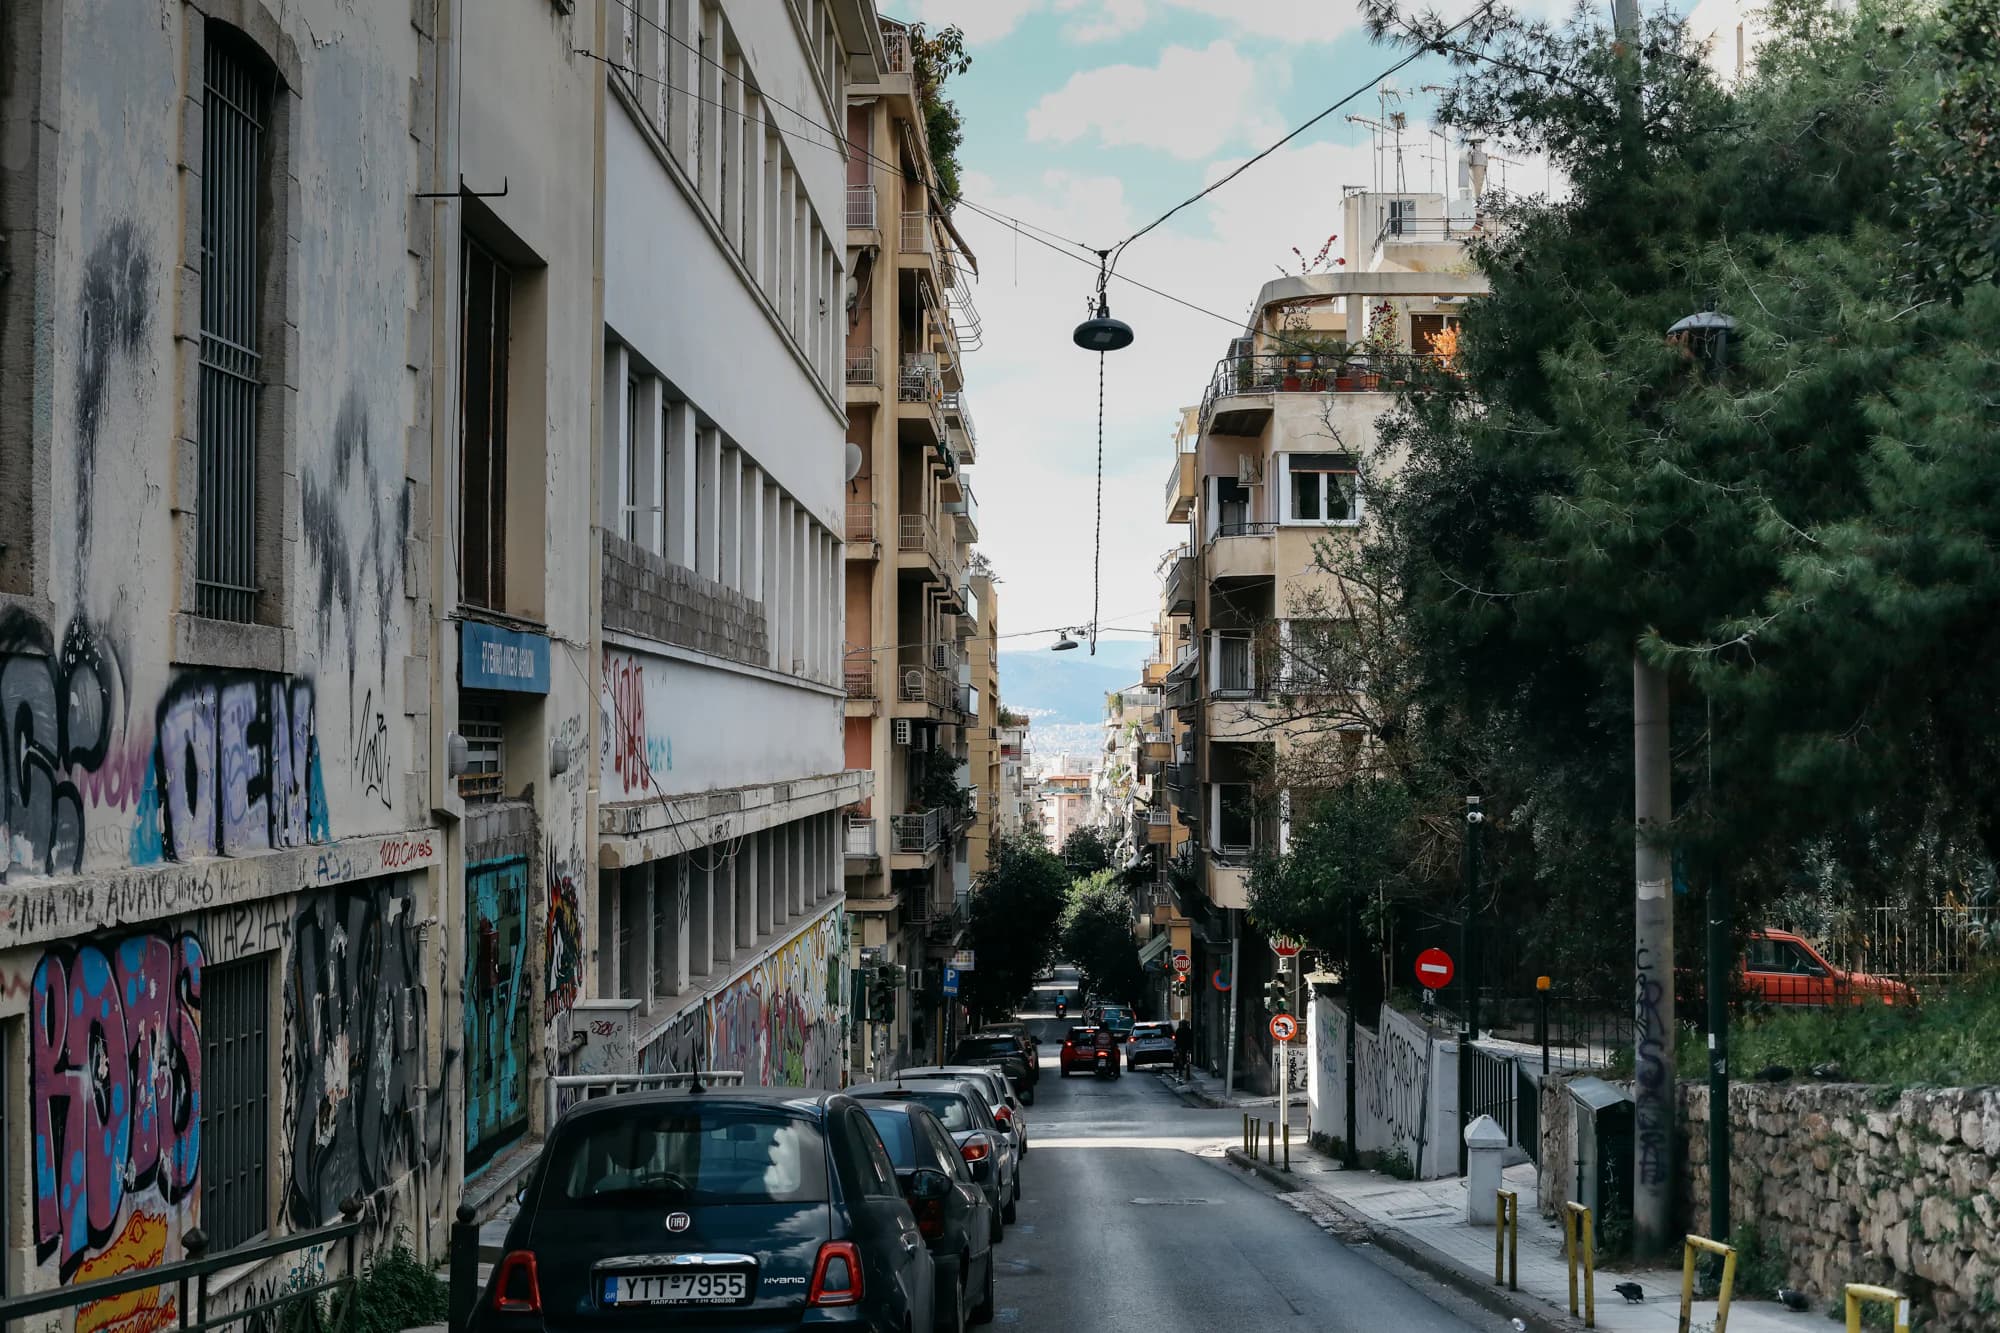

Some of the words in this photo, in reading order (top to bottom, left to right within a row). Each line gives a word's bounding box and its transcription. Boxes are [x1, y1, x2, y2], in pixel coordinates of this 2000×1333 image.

[1175, 959, 1190, 969] STOP
[670, 1217, 685, 1228] FIAT
[764, 1276, 806, 1284] HYBRID
